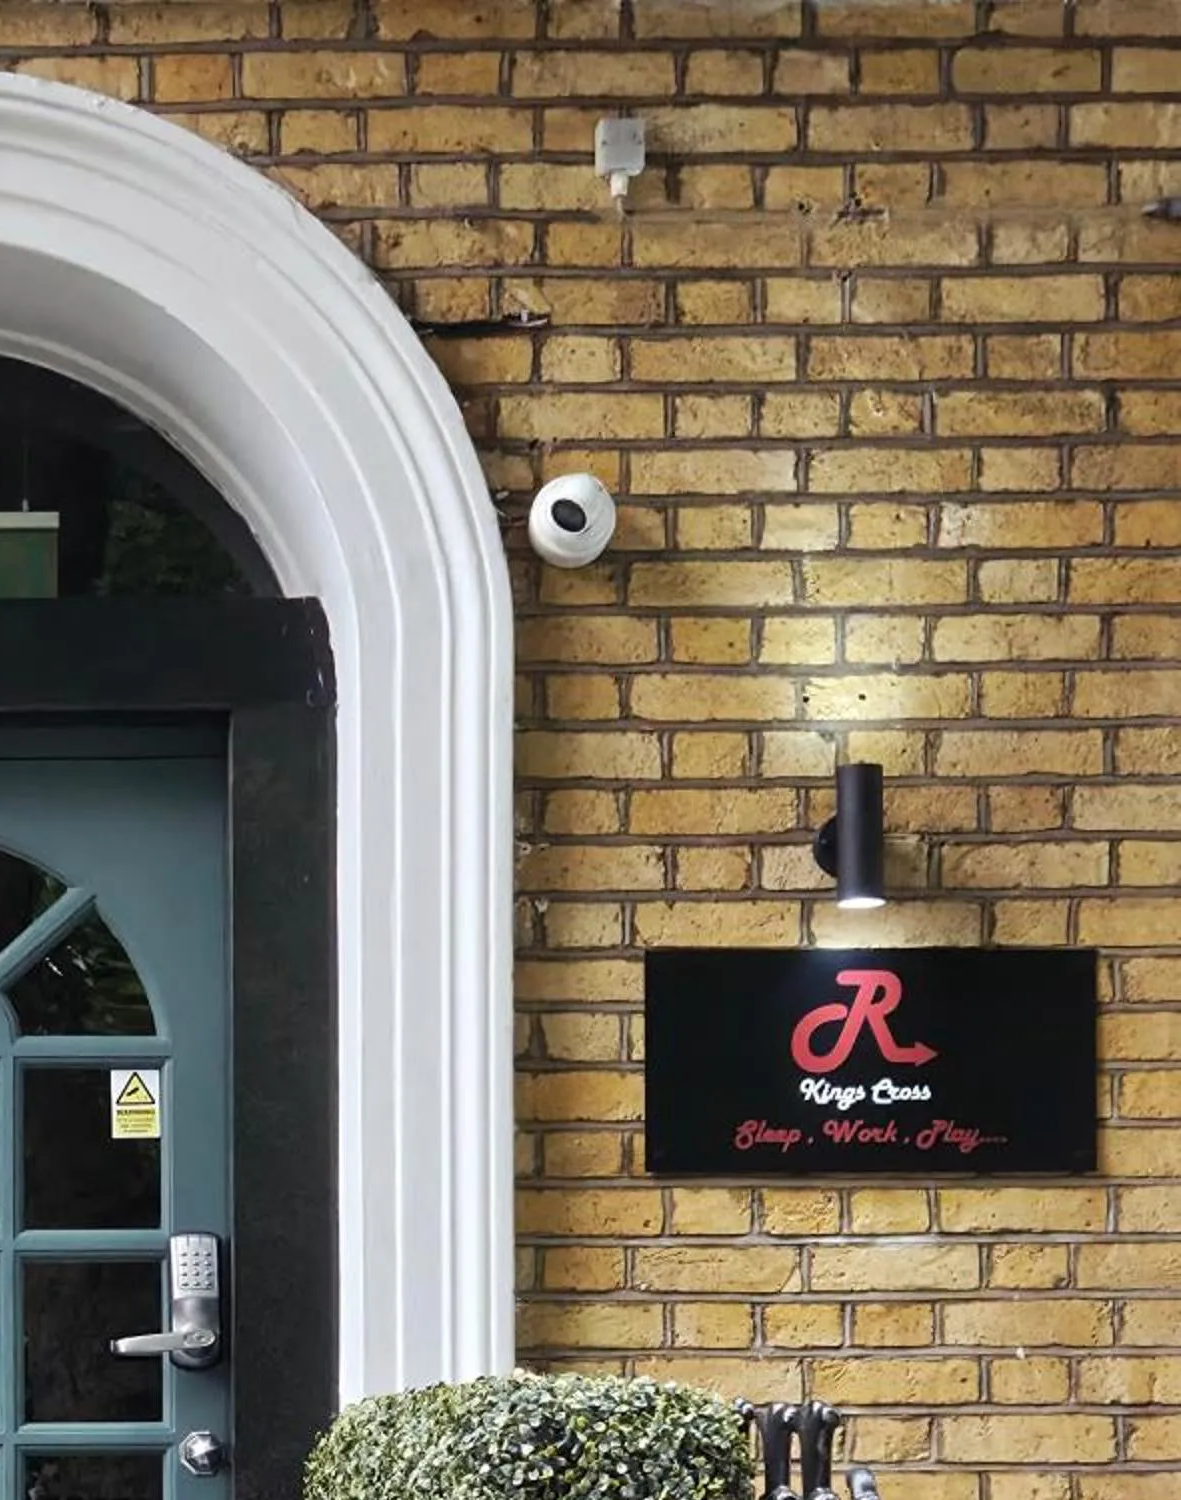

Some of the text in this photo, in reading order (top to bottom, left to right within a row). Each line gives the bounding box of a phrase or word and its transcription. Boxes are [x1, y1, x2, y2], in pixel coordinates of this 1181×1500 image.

[798, 1077, 933, 1112] Kings Cross
[822, 1119, 897, 1145] Work
